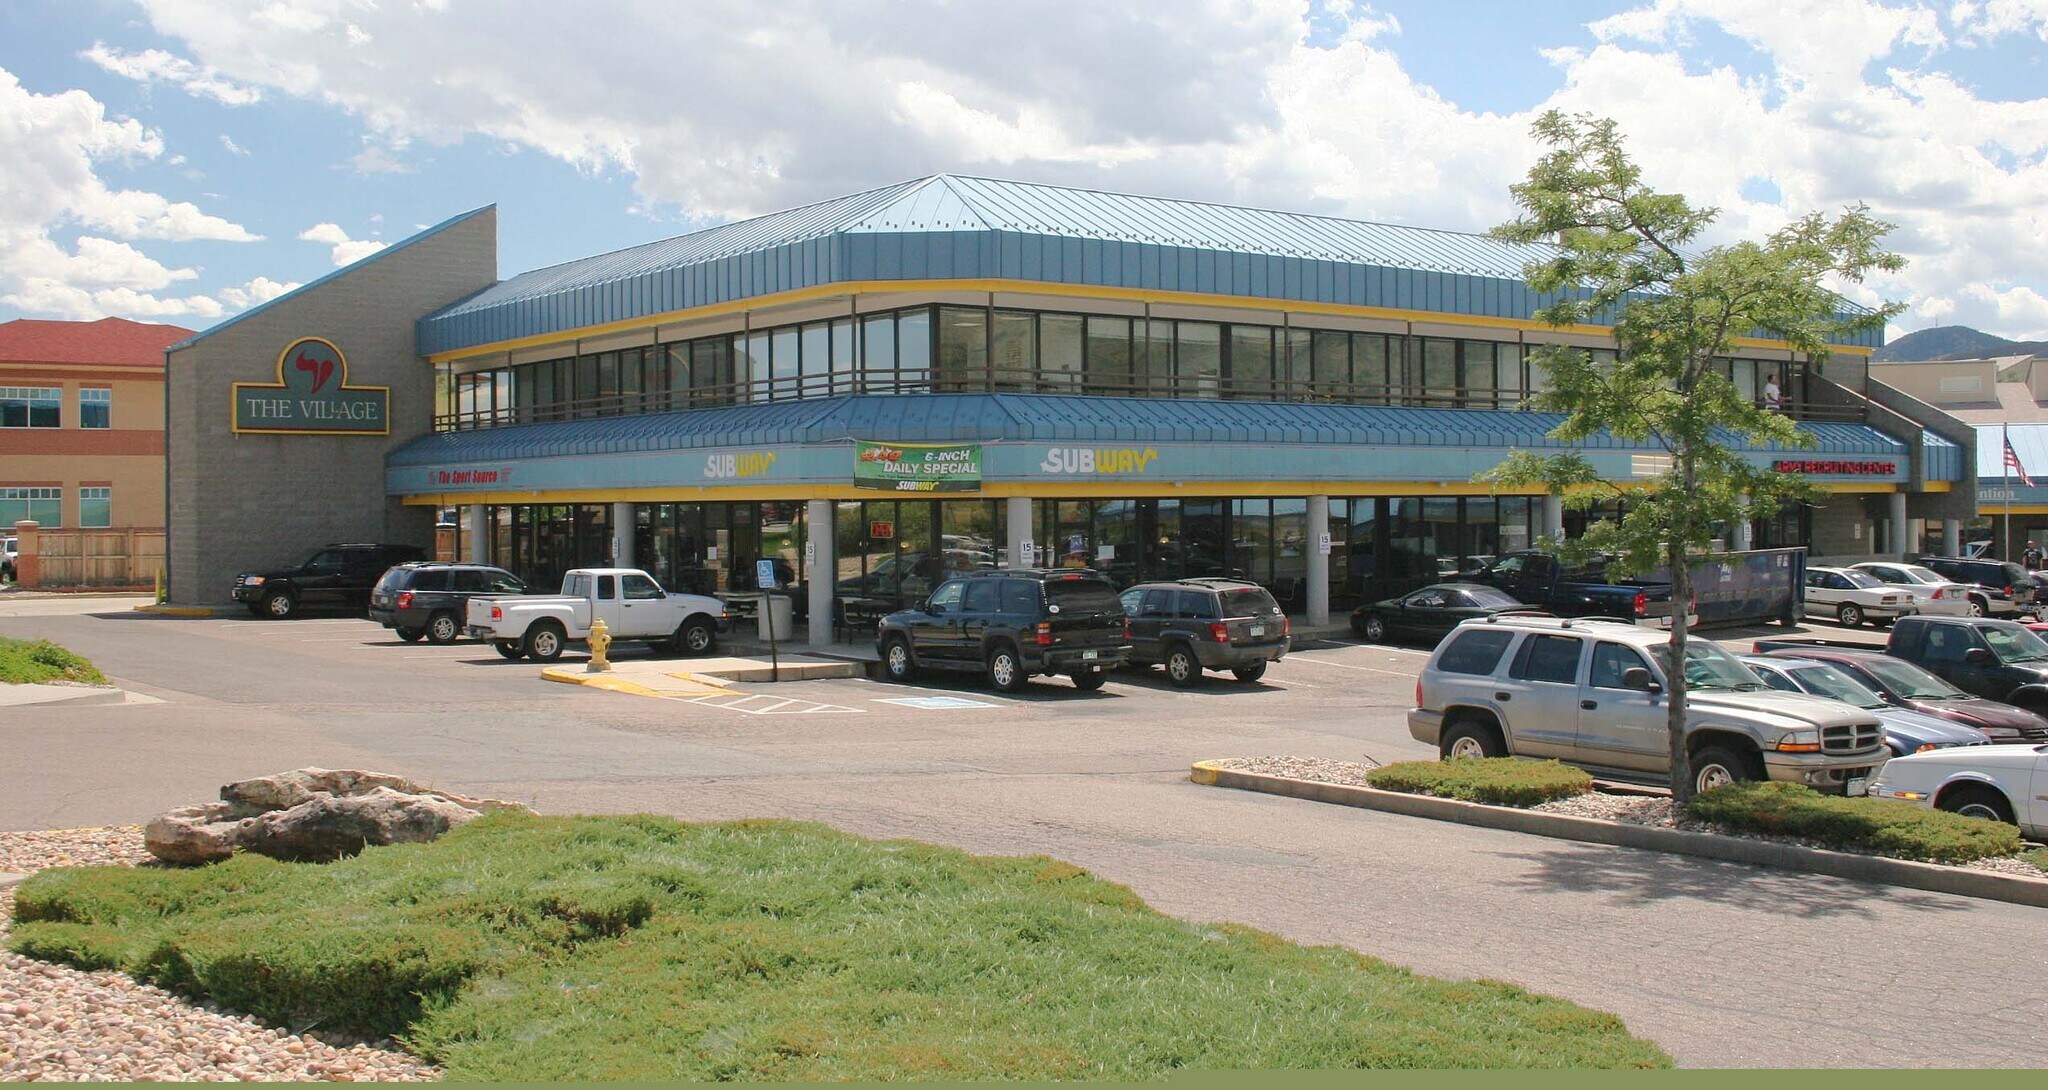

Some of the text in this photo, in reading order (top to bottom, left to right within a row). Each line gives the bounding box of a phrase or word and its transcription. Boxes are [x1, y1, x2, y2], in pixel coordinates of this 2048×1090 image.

[246, 399, 379, 420] THE VILLAGE
[924, 449, 971, 461] 6-INCH
[1040, 447, 1158, 474] SUBWAY
[703, 450, 777, 478] SUBWAY
[883, 462, 978, 474] DAILY SPECIAL
[1804, 460, 1861, 474] RECRUITING
[1861, 461, 1897, 474] CENTER
[438, 469, 498, 485] The Sport Source
[895, 480, 940, 491] SUBWAY
[1022, 543, 1032, 552] 15
